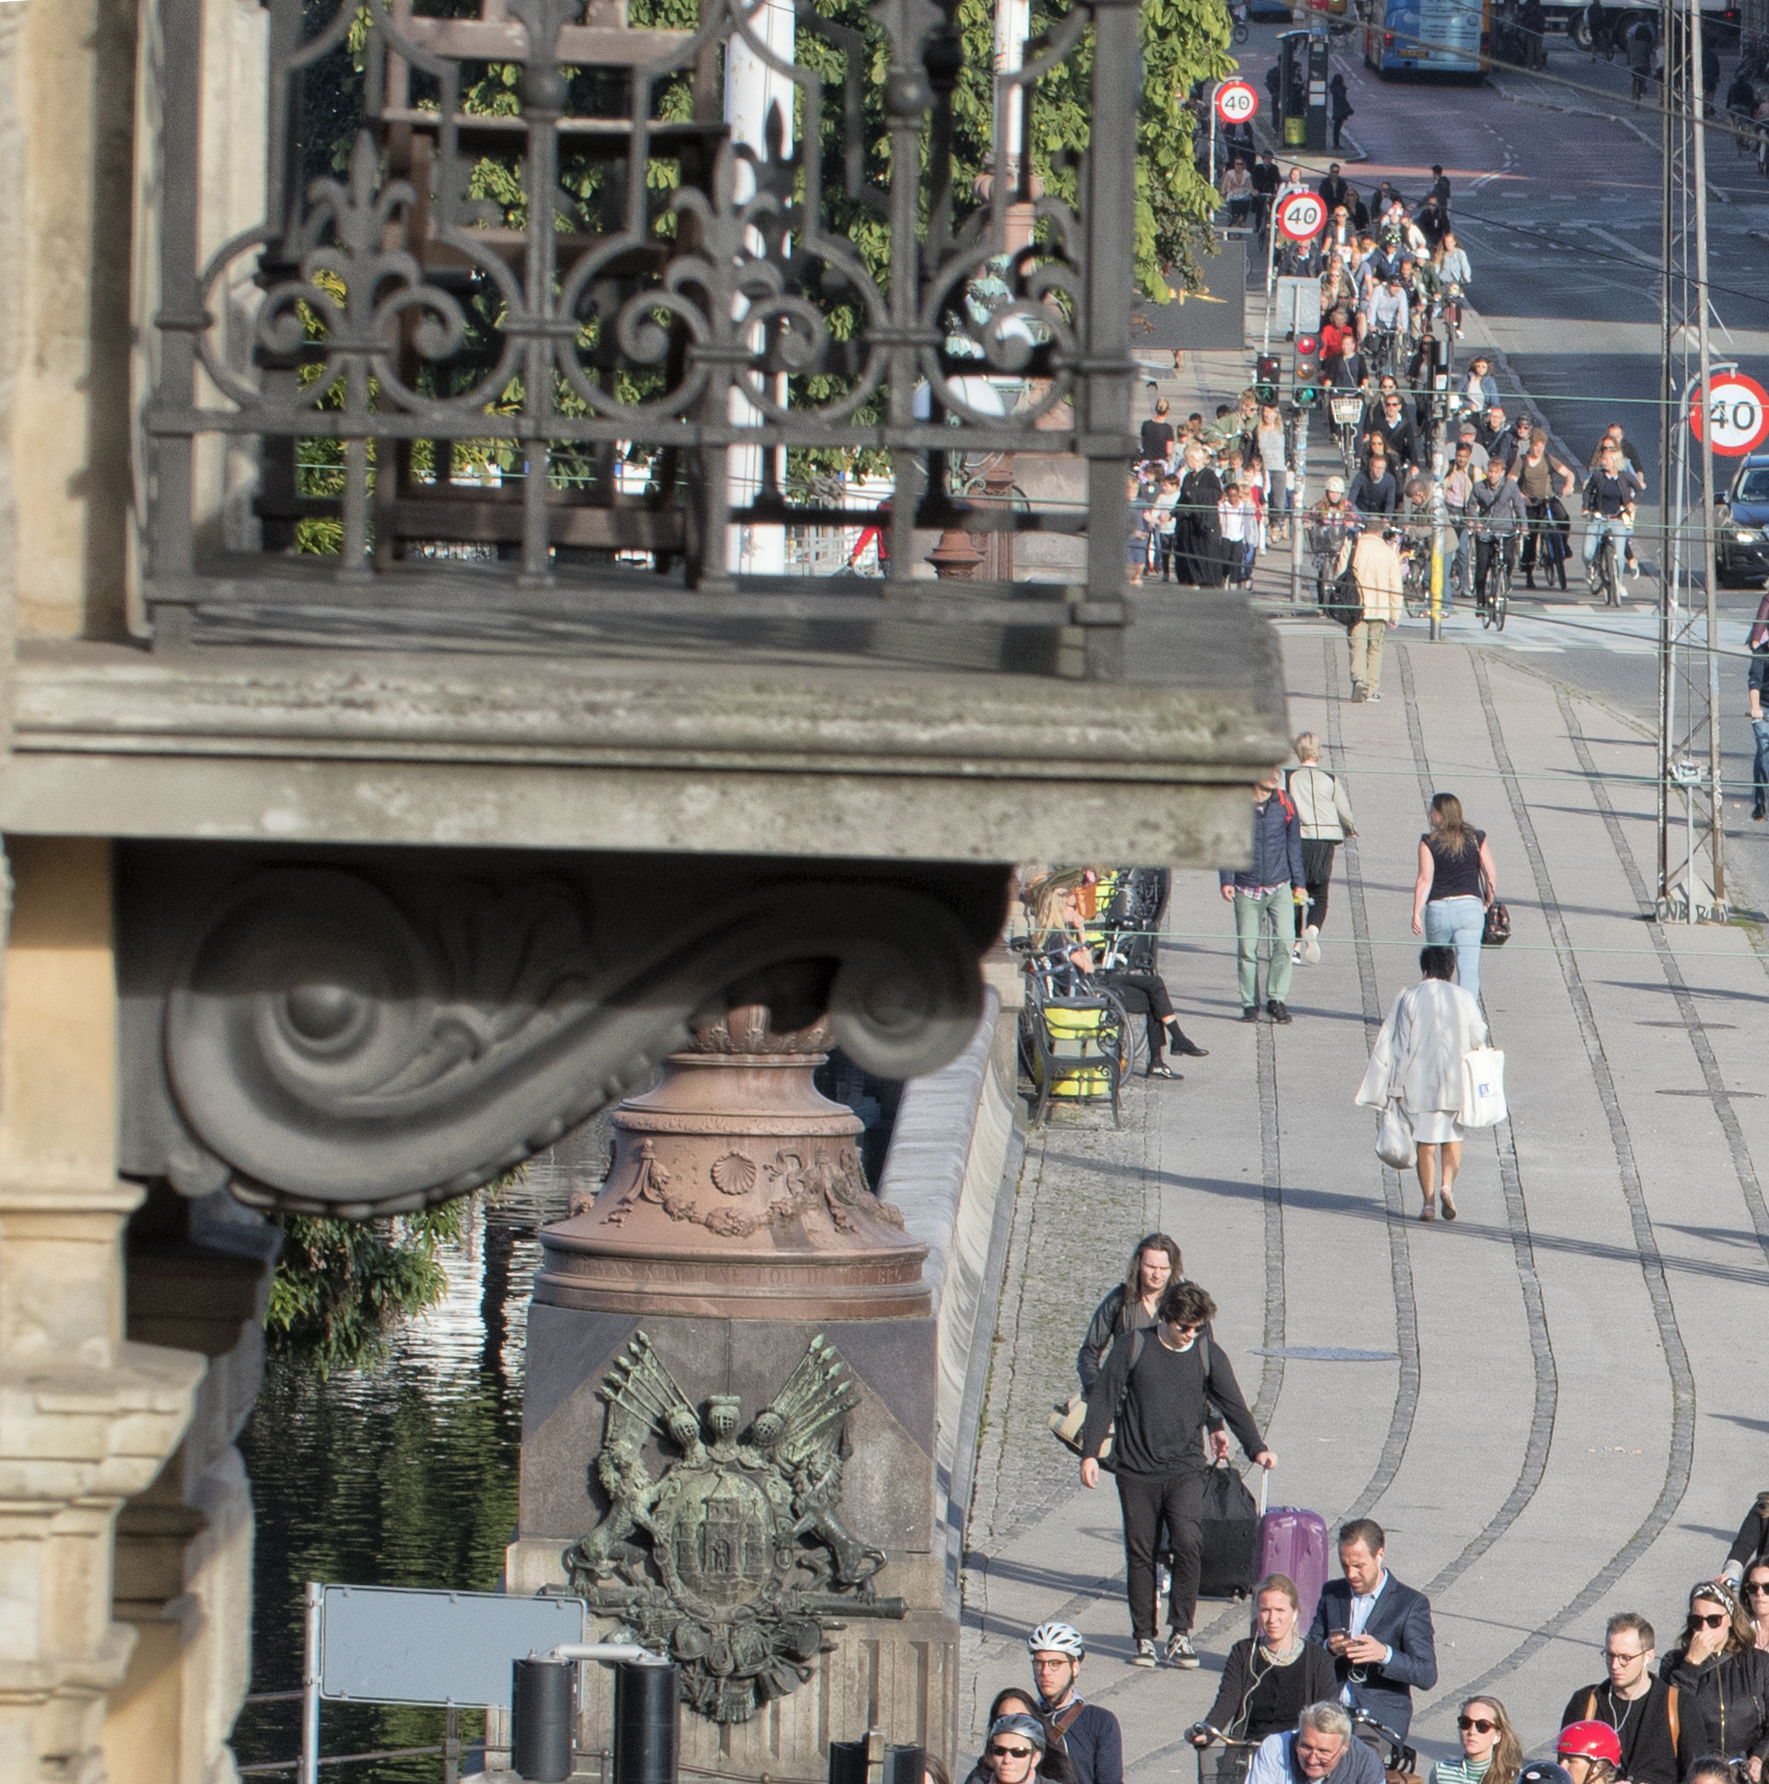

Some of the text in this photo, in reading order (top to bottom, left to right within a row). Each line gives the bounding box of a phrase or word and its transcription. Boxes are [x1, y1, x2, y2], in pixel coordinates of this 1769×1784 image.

[1224, 95, 1250, 111] 40
[1286, 207, 1318, 225] 40
[1710, 400, 1755, 432] 40
